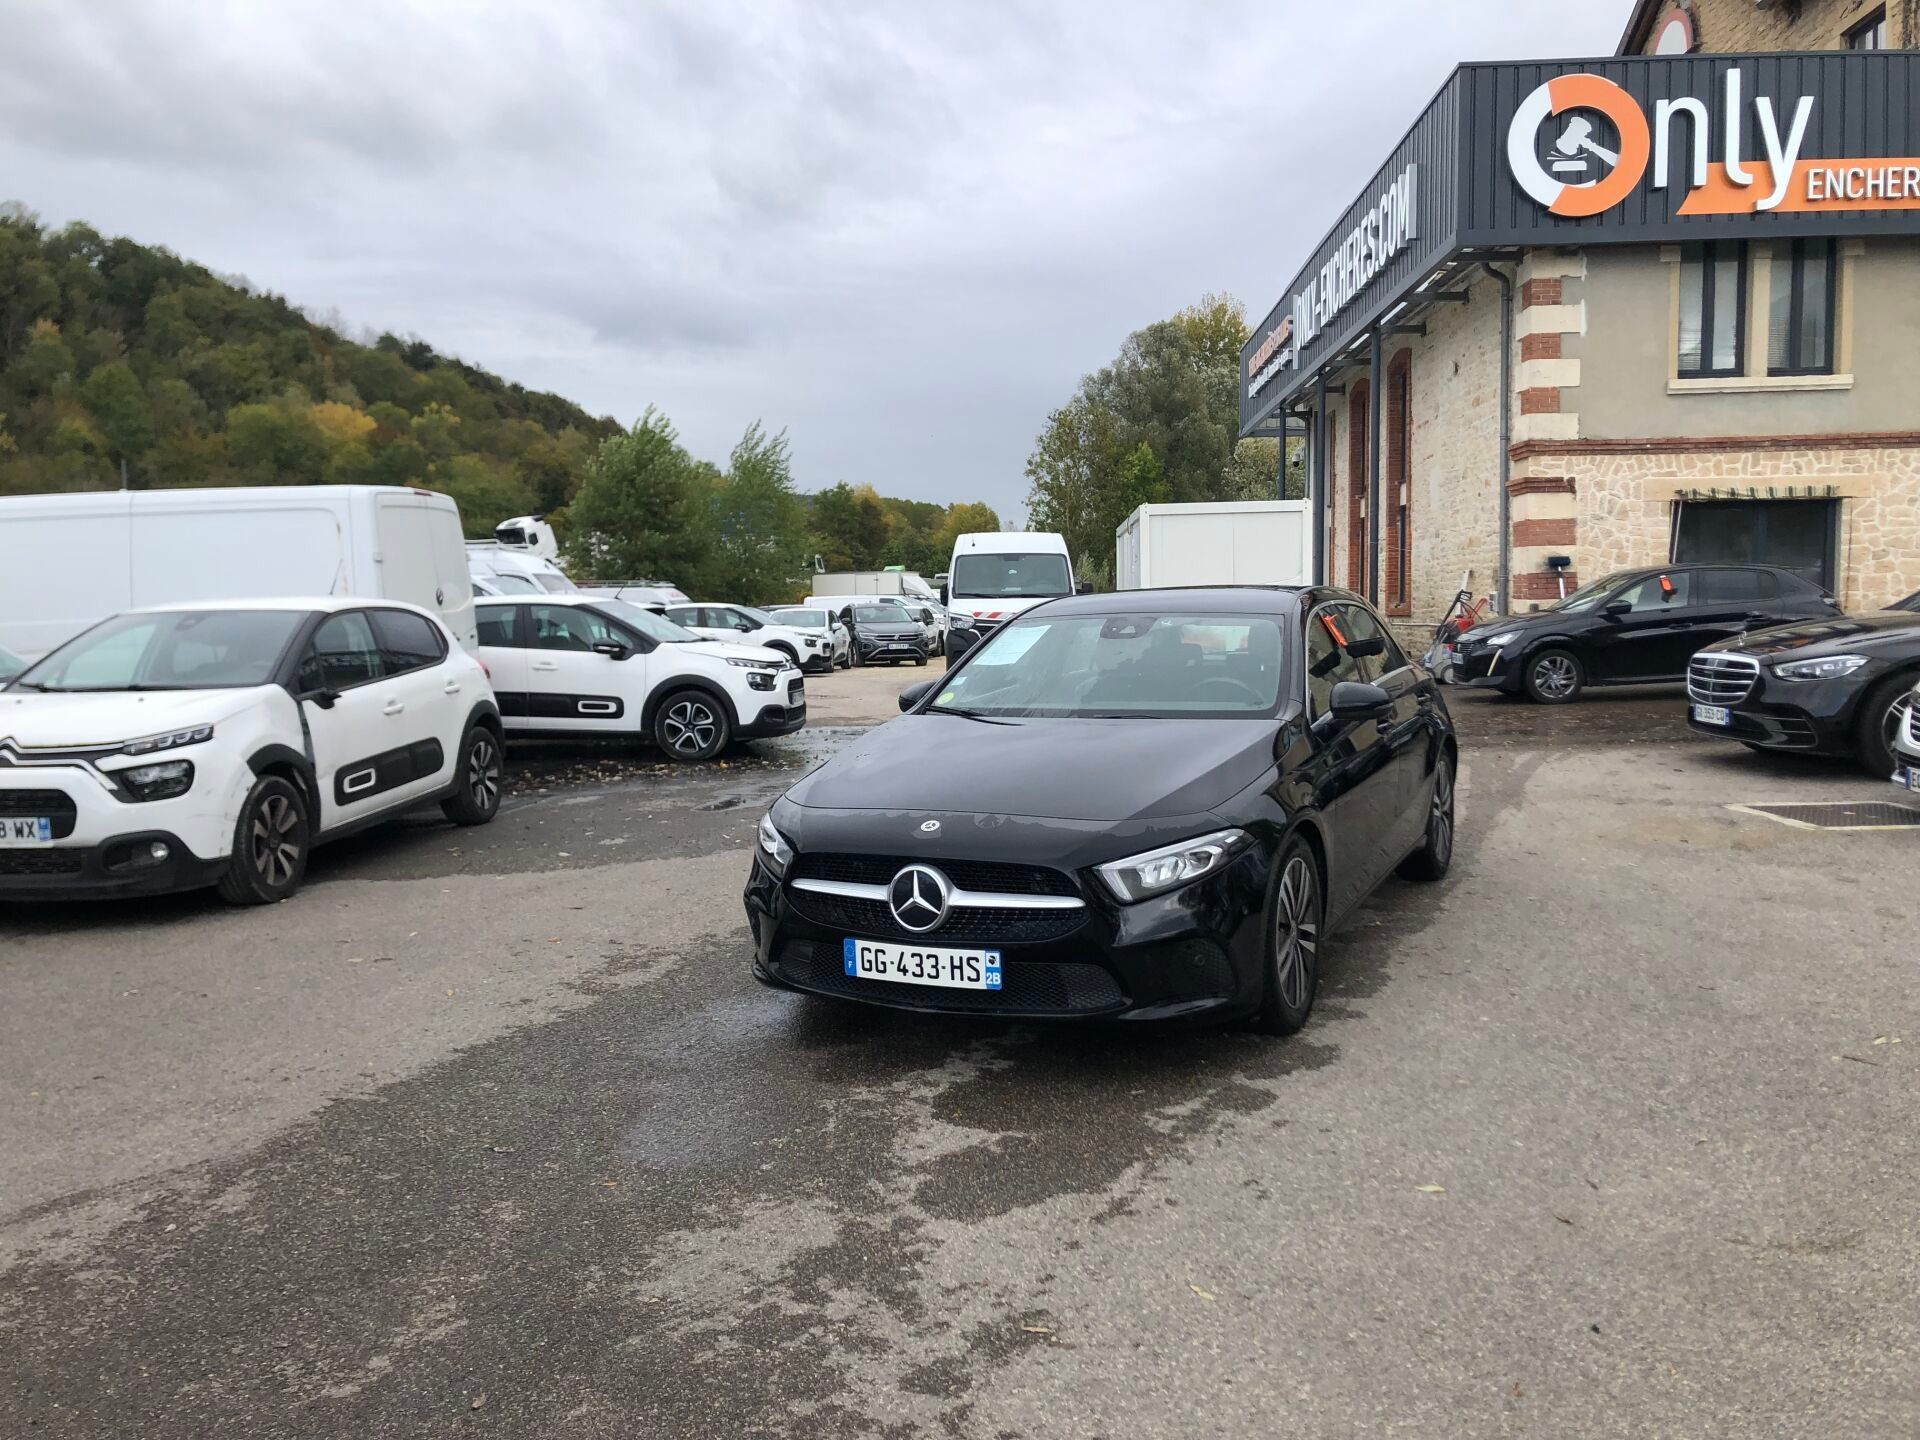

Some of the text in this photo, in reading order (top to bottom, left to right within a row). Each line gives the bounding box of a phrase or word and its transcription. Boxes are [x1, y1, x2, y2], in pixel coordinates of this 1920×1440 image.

[1507, 67, 1815, 217] Only
[1807, 166, 1920, 200] ENCHER
[1295, 163, 1417, 352] ONLY-ENCHERES.COM
[860, 946, 981, 982] GG-433-HS
[986, 972, 1000, 985] 2B
